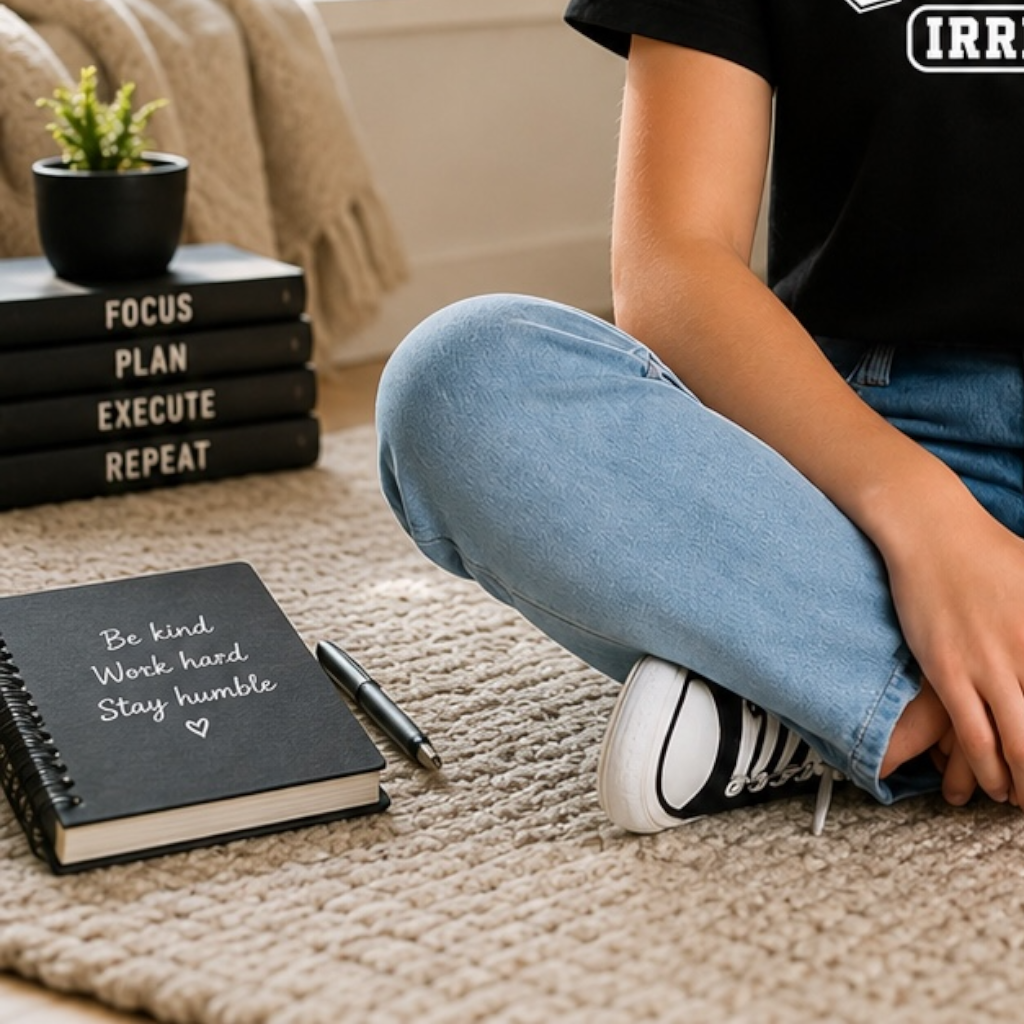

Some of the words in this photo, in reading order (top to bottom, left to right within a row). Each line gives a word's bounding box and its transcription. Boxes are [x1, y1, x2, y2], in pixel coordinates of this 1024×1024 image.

[105, 293, 193, 329] FOCUS
[115, 343, 188, 379] PLAN
[97, 389, 216, 432] EXECUTE
[105, 440, 212, 483] REPEAT
[99, 628, 142, 652] Be
[149, 615, 215, 643] kind
[91, 655, 173, 687] Work
[179, 642, 249, 670] hard
[97, 691, 169, 723] Stay
[175, 674, 278, 707] humble
